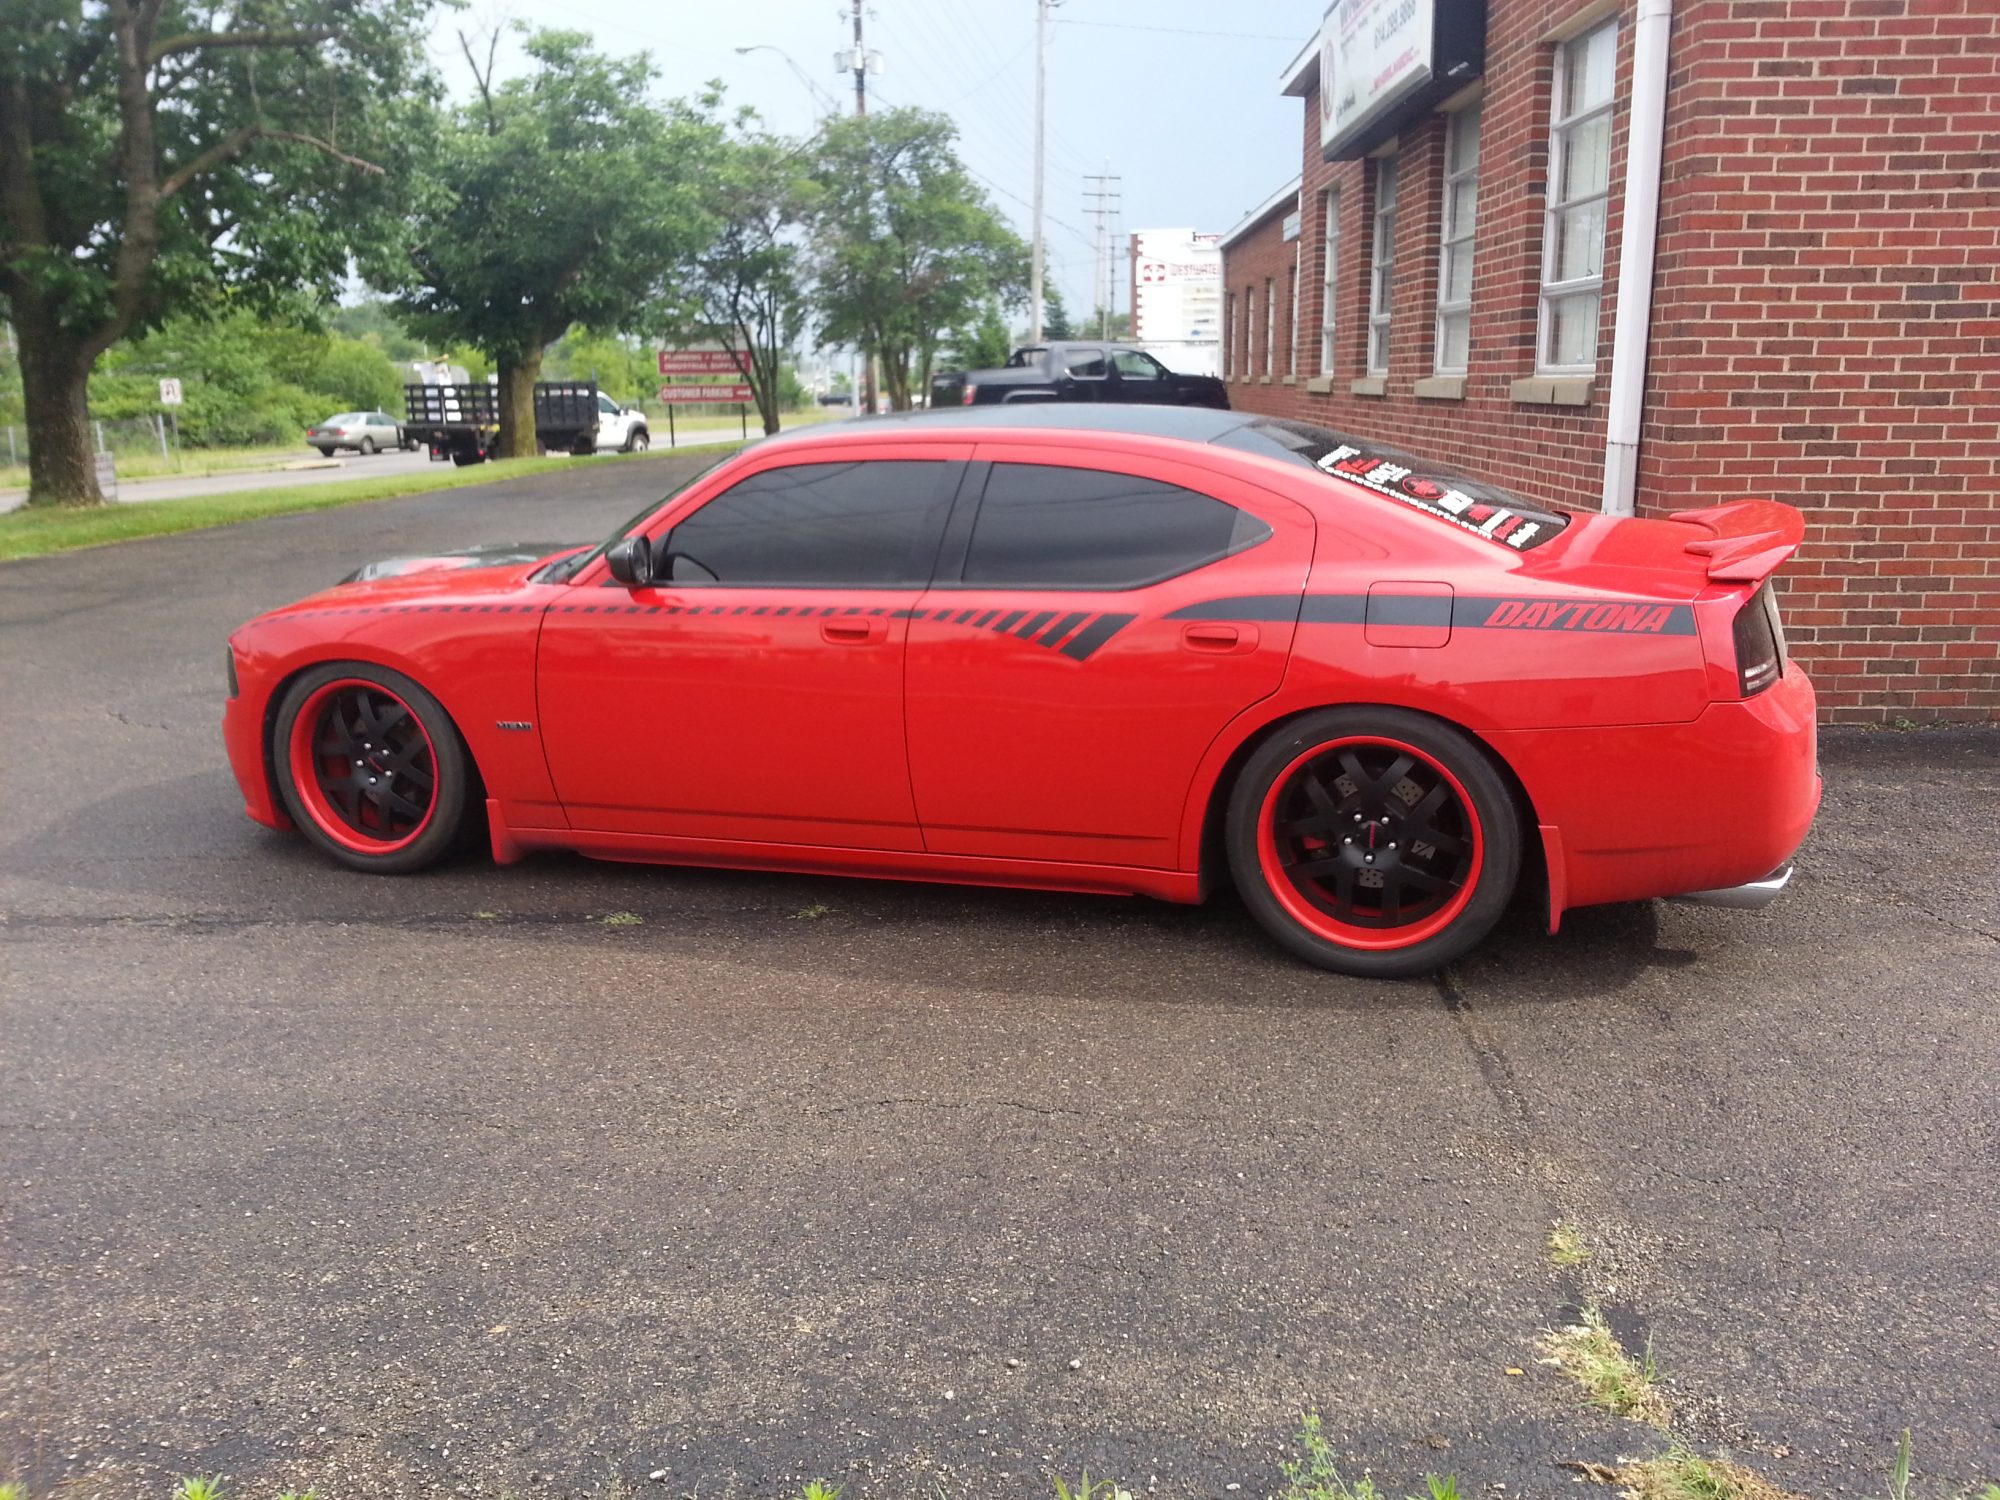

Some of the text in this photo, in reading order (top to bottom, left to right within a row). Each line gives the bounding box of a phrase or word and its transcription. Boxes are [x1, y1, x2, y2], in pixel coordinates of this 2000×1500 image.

[663, 387, 733, 400] CUSTOMER PARKING
[1483, 601, 1675, 632] DAYTONA
